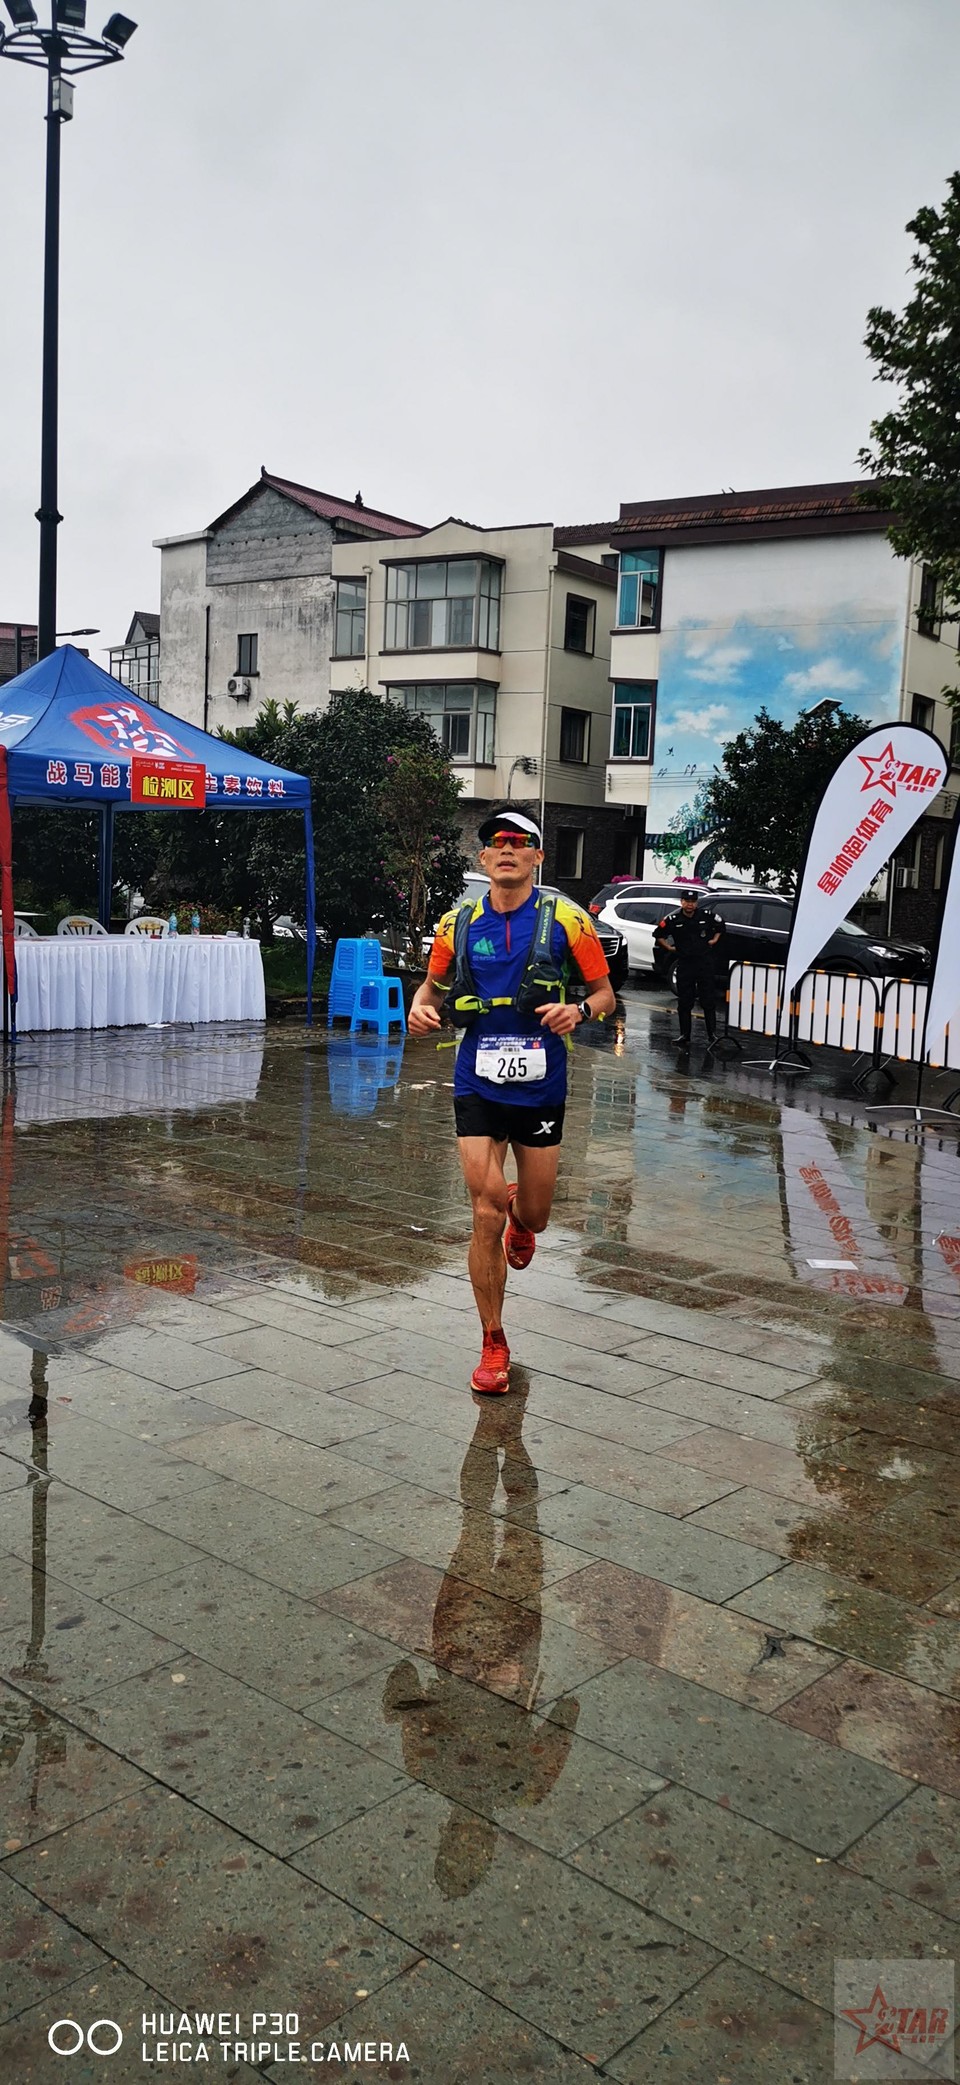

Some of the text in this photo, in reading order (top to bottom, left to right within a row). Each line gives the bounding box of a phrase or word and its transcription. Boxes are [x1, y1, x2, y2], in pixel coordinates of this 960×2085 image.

[142, 775, 195, 800] 检测区
[816, 798, 894, 896] 星帅跑体育
[497, 1057, 527, 1078] 265
